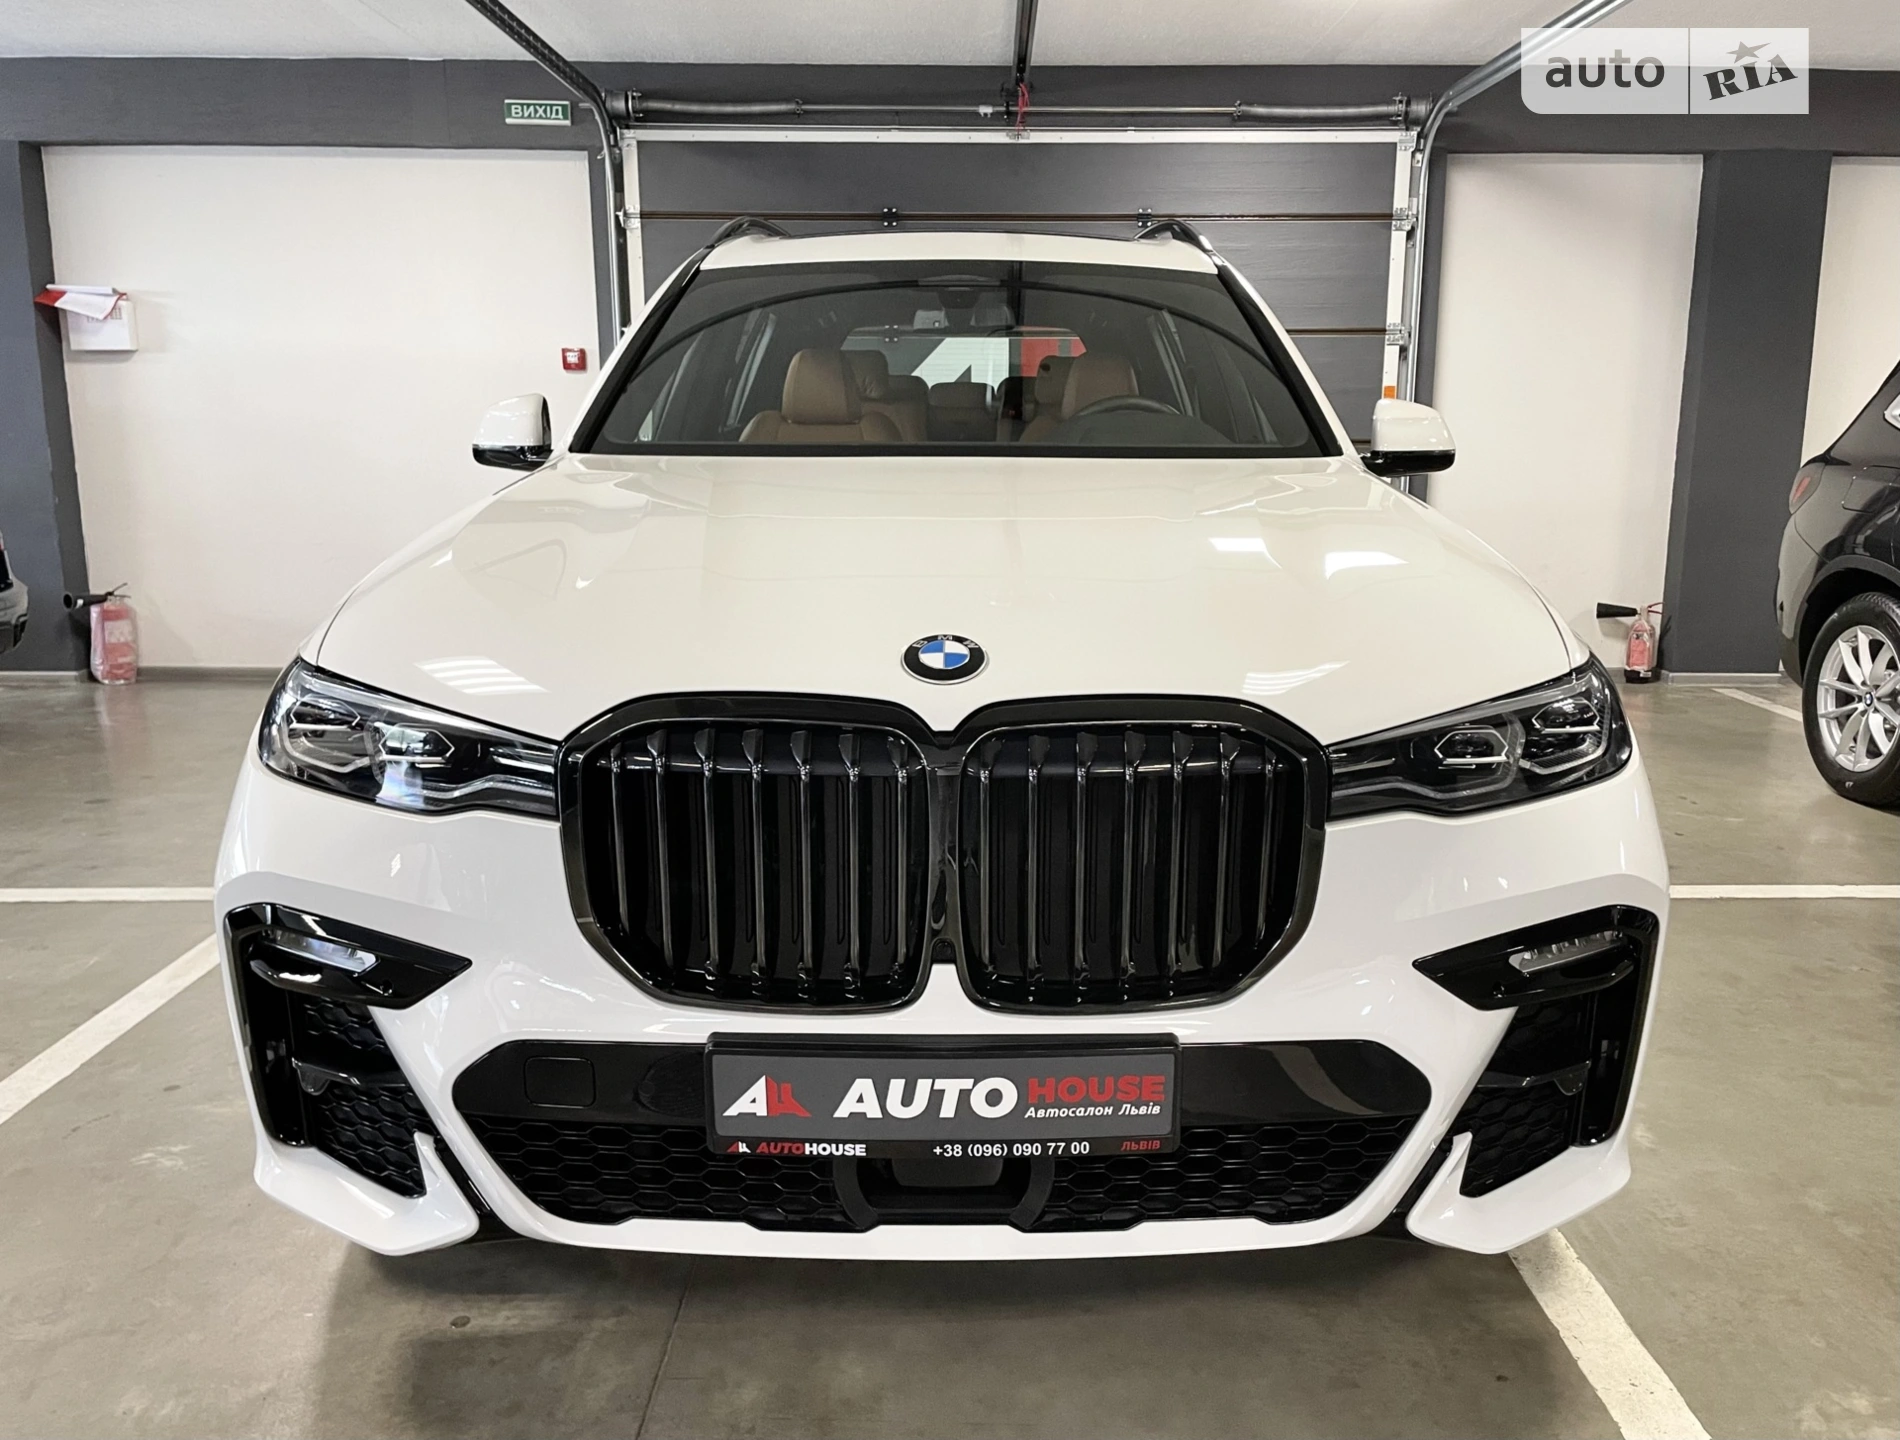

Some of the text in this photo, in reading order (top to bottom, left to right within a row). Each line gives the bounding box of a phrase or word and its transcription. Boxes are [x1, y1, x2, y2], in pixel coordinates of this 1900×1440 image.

[511, 104, 564, 119] ВИХІД
[911, 634, 980, 648] BMW
[832, 1075, 1166, 1119] AUTO HOUSE
[1024, 1102, 1161, 1119] Автосалон Львів
[756, 1142, 867, 1156] AUTOHOUSE
[933, 1141, 1090, 1157] +38 (096) 090 77 00
[1120, 1140, 1161, 1152] ЛЬВІВ
